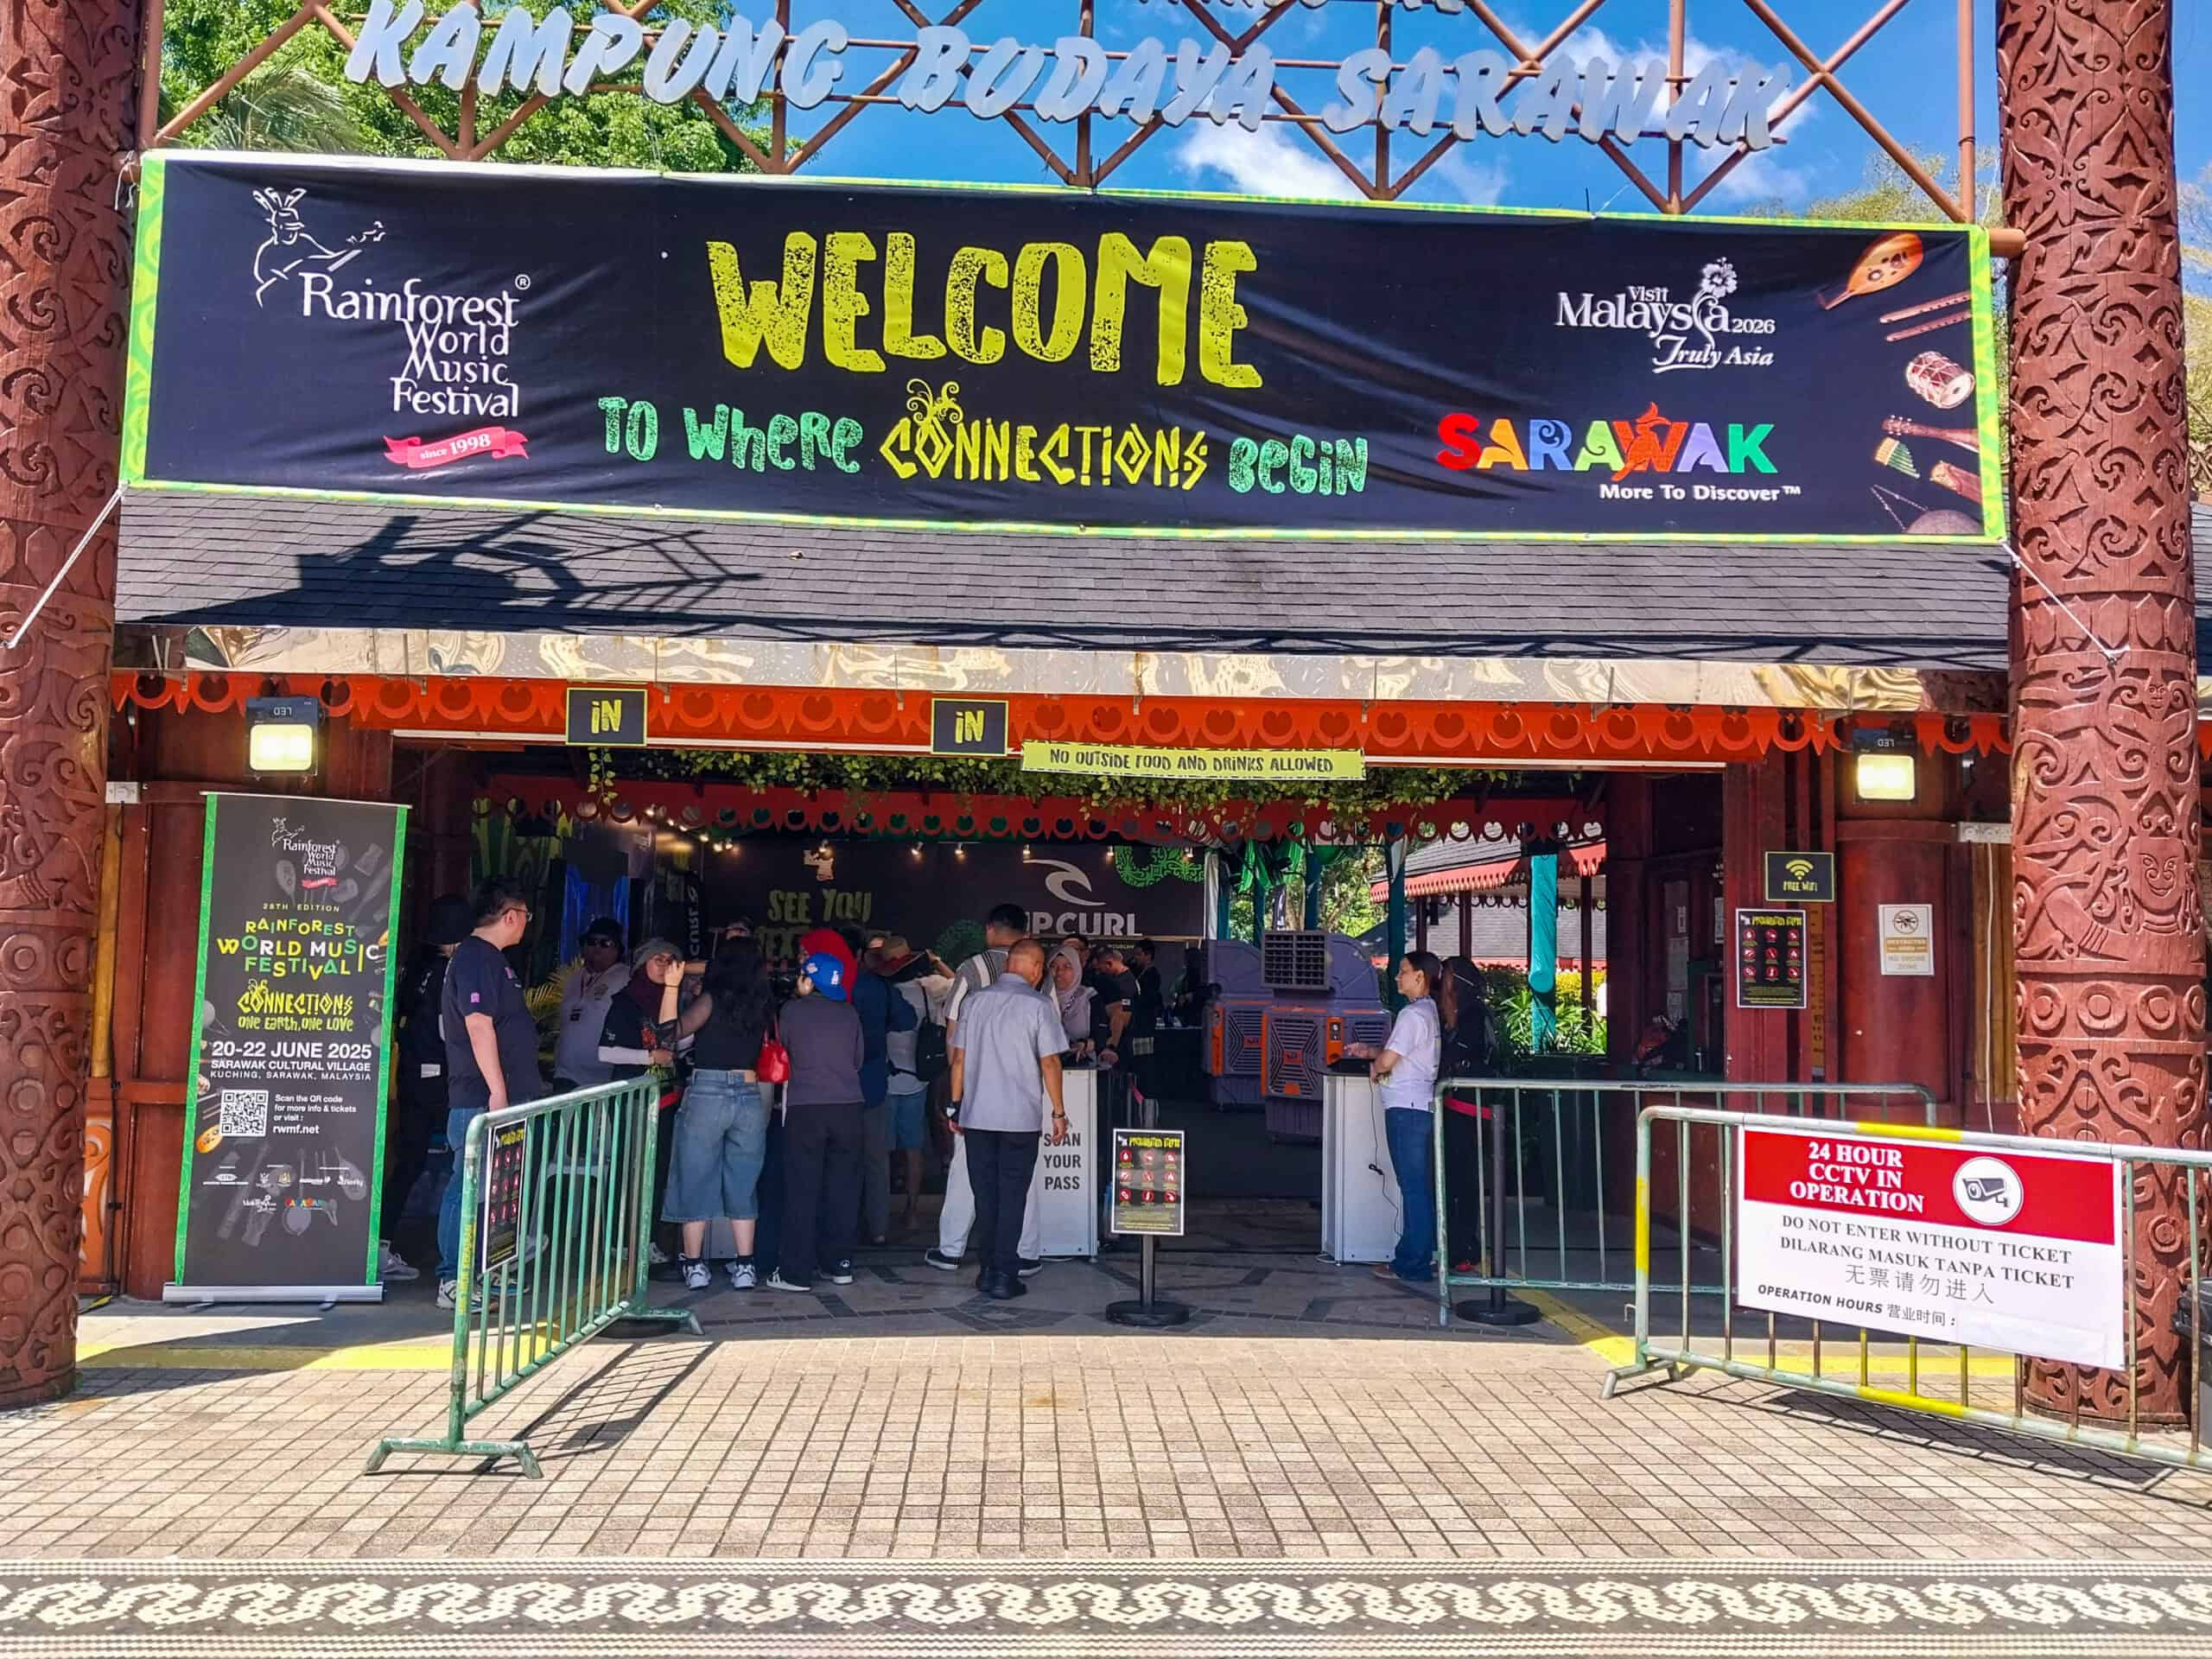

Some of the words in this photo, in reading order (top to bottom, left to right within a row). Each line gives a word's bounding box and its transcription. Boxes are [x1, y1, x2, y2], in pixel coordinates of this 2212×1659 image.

[345, 0, 849, 108] KAMPUNG
[897, 24, 1276, 132] BUDAYA
[1322, 48, 1791, 151] SARAWAK
[299, 272, 520, 327] Rainforest
[1628, 286, 1669, 302] Visit
[705, 231, 1264, 389] WELCOME
[1554, 292, 1731, 338] Malaysia
[1732, 318, 1776, 334] 2026
[397, 319, 509, 355] World
[1653, 334, 1721, 372] Truly
[1724, 346, 1775, 366] Asia
[400, 349, 509, 384] Music
[390, 378, 518, 417] Festival
[598, 397, 658, 461] TO
[420, 448, 448, 459] since
[449, 434, 492, 455] 1998
[1436, 408, 1778, 480] SARAWAK
[1599, 484, 1653, 499] More
[1660, 484, 1685, 500] To
[1050, 748, 1071, 764] NO
[1135, 754, 1172, 771] FOOD
[1177, 755, 1207, 772] AND
[1270, 755, 1333, 773] ALLOWED
[296, 904, 340, 912] EDITION
[767, 889, 812, 924] SEE
[822, 888, 872, 923] YOU
[245, 918, 355, 937] RAINFOREST
[1056, 912, 1143, 937] CURL
[216, 935, 302, 957] WORLD
[309, 939, 380, 972] MUSIC
[244, 957, 351, 981] FESTIVAL
[212, 1040, 267, 1057] 20-22
[270, 1042, 323, 1058] JUNE
[327, 1043, 372, 1059] 2025
[211, 1059, 266, 1070] SARAWAK
[269, 1060, 324, 1071] CULTURAL
[327, 1062, 372, 1071] VILLAGE
[321, 1072, 372, 1081] MALAYSIA
[274, 1103, 285, 1112] for
[275, 1094, 295, 1103] Scan
[296, 1094, 308, 1103] the
[309, 1095, 321, 1103] QR
[323, 1095, 343, 1103] code
[273, 1124, 320, 1135] rwmf.net
[283, 1113, 299, 1122] visit
[1043, 1154, 1082, 1168] YOUR
[1808, 1141, 1831, 1160] 24
[1835, 1143, 1904, 1167] HOUR
[1045, 1175, 1080, 1190] PASS
[1808, 1162, 1872, 1185] CCTV
[1876, 1169, 1904, 1189] IN
[1789, 1180, 1925, 1214] OPERATION
[1782, 1214, 1804, 1230] DO
[1808, 1217, 1842, 1235] NOT
[1846, 1223, 1902, 1243] ENTER
[1905, 1230, 1994, 1253] WITHOUT
[1997, 1241, 2073, 1265] TICKET
[1780, 1236, 1864, 1260] DILARANG
[1868, 1249, 1930, 1269] MASUK
[1934, 1257, 1995, 1279] TANPA
[2000, 1266, 2075, 1290] TICKET
[1845, 1263, 1994, 1304] 无票请勿进入
[1758, 1283, 1832, 1306] OPERATION
[1836, 1297, 1883, 1314] HOURS
